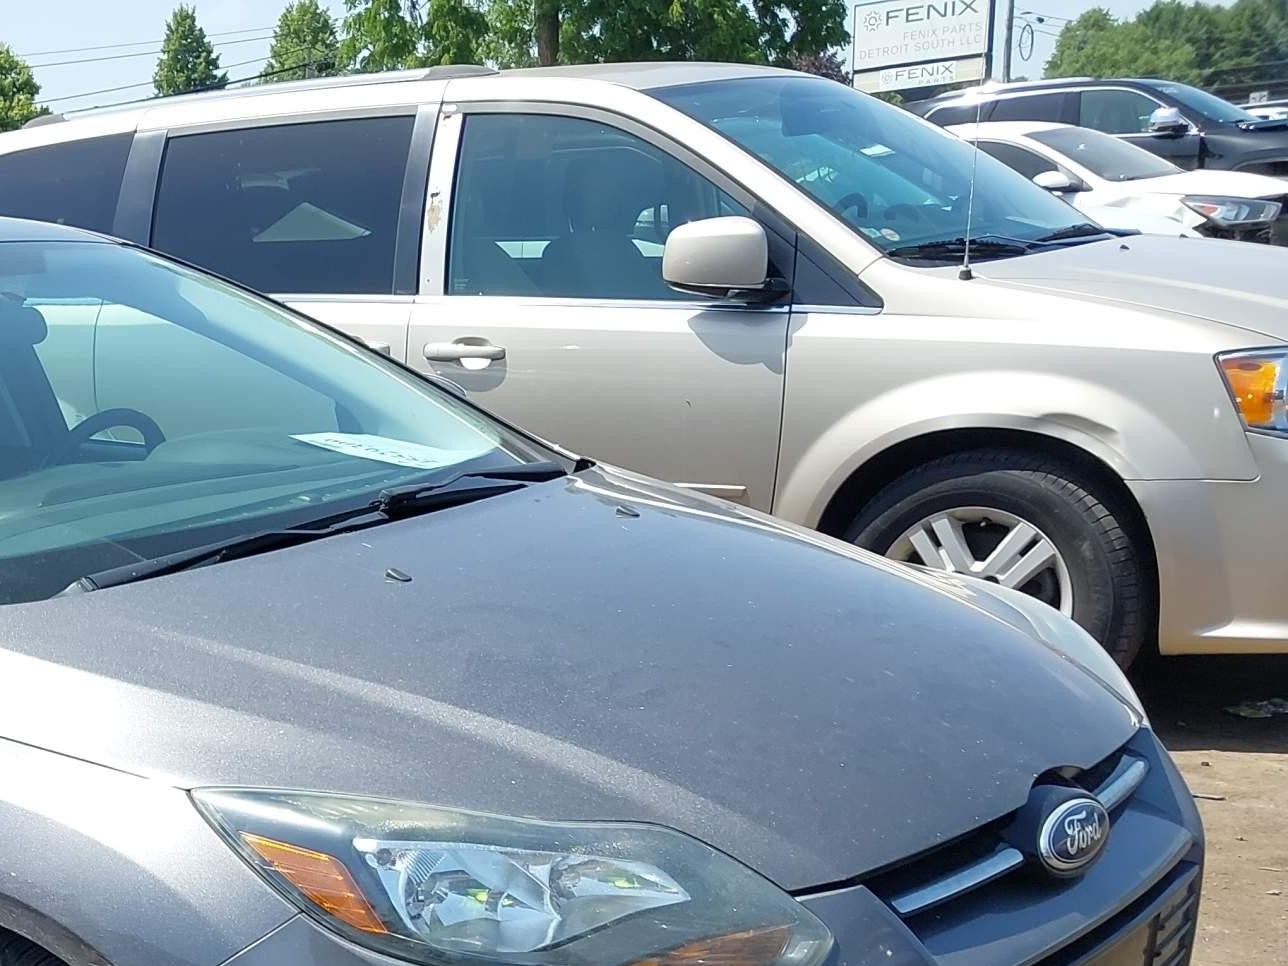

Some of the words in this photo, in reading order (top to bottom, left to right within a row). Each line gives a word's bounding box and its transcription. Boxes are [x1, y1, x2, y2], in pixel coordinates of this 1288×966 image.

[885, 0, 979, 26] FENIX
[903, 28, 938, 41] FENIX
[942, 22, 983, 34] PARTS
[859, 43, 909, 60] DETROIT
[914, 37, 955, 52] SOUTH
[960, 34, 982, 46] LLC
[895, 63, 954, 81] FENIX
[1064, 809, 1103, 856] Ford
